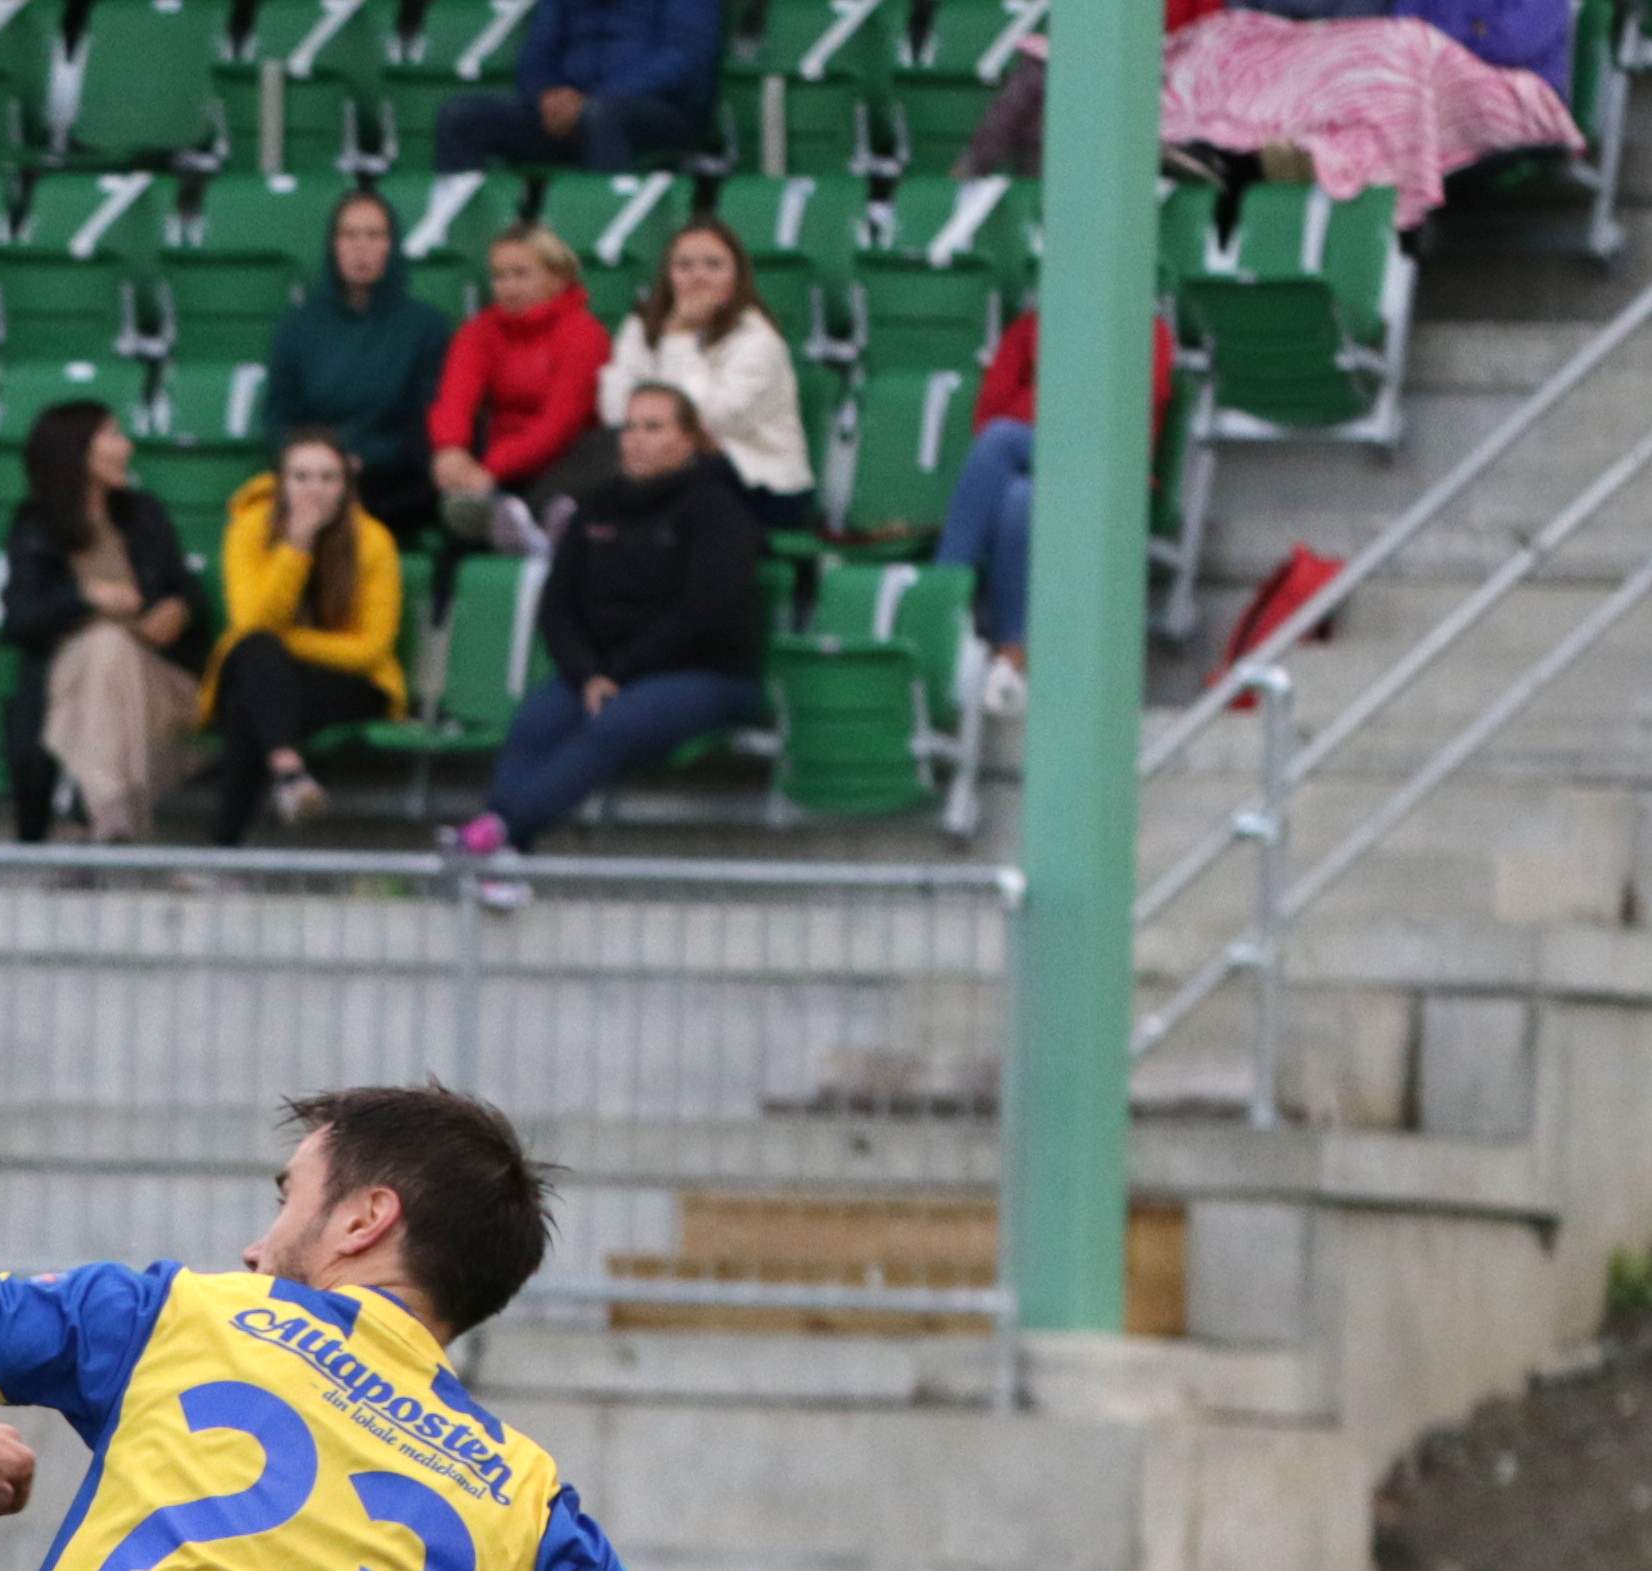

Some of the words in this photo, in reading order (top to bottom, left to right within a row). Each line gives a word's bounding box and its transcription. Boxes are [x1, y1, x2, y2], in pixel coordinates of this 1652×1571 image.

[234, 1308, 513, 1506] Altaposten
[322, 1386, 351, 1413] din
[350, 1406, 399, 1446] lokale
[398, 1440, 487, 1500] mediekanal
